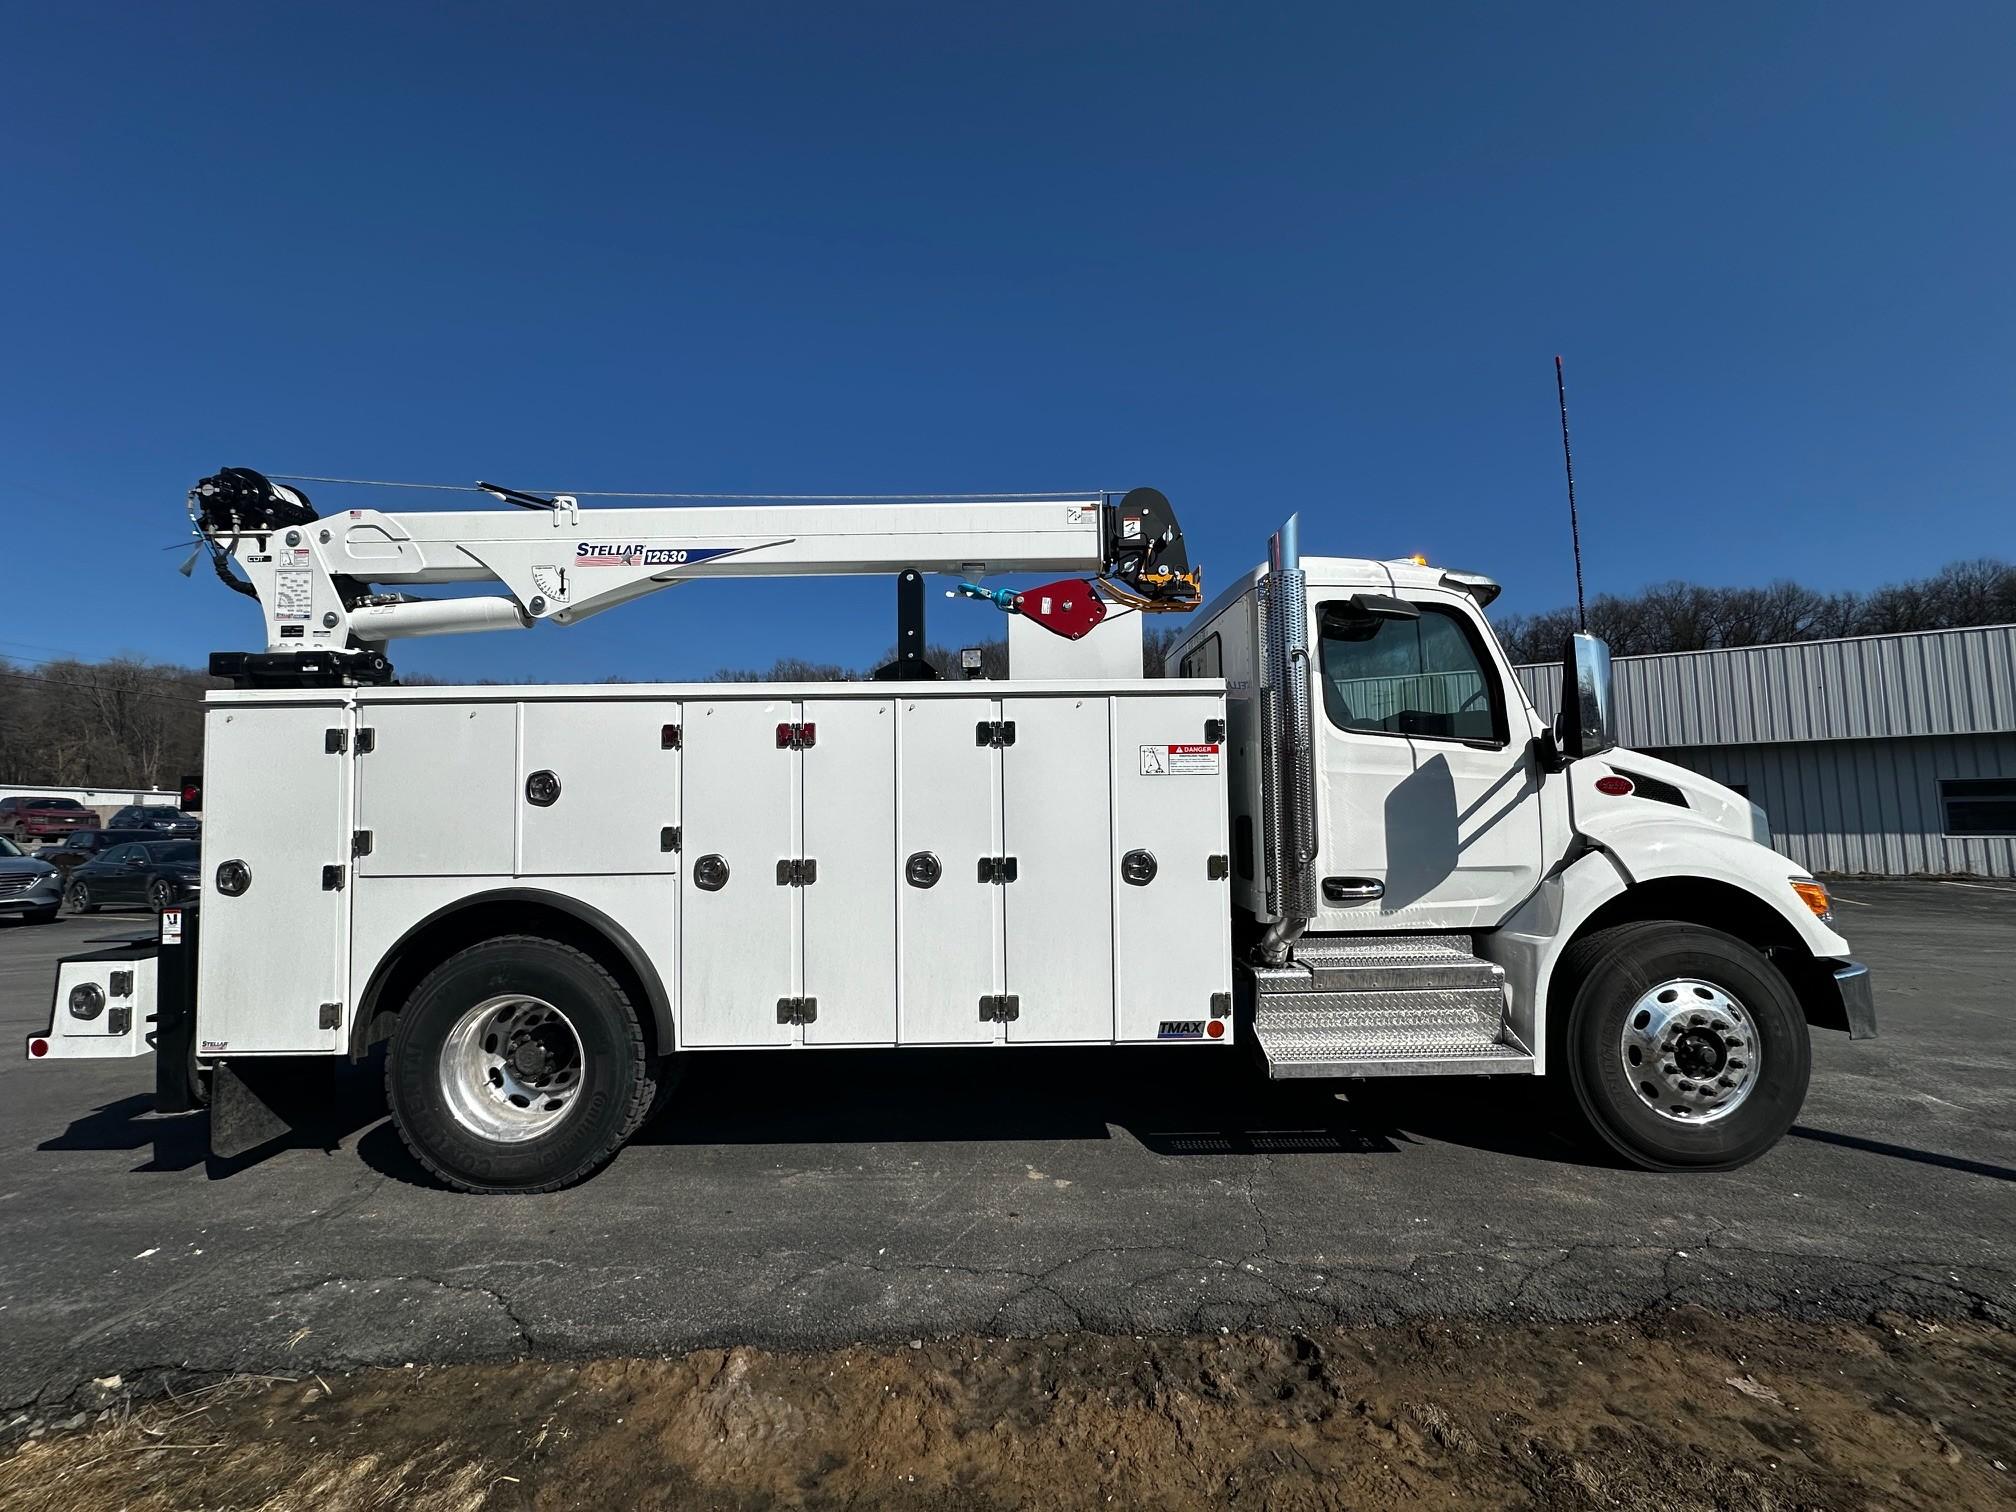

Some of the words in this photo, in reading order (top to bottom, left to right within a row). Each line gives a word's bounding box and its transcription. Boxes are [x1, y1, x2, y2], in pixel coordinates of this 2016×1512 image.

[576, 542, 645, 556] STELLAR
[646, 551, 688, 563] 12630
[1159, 1022, 1202, 1034] TMAX
